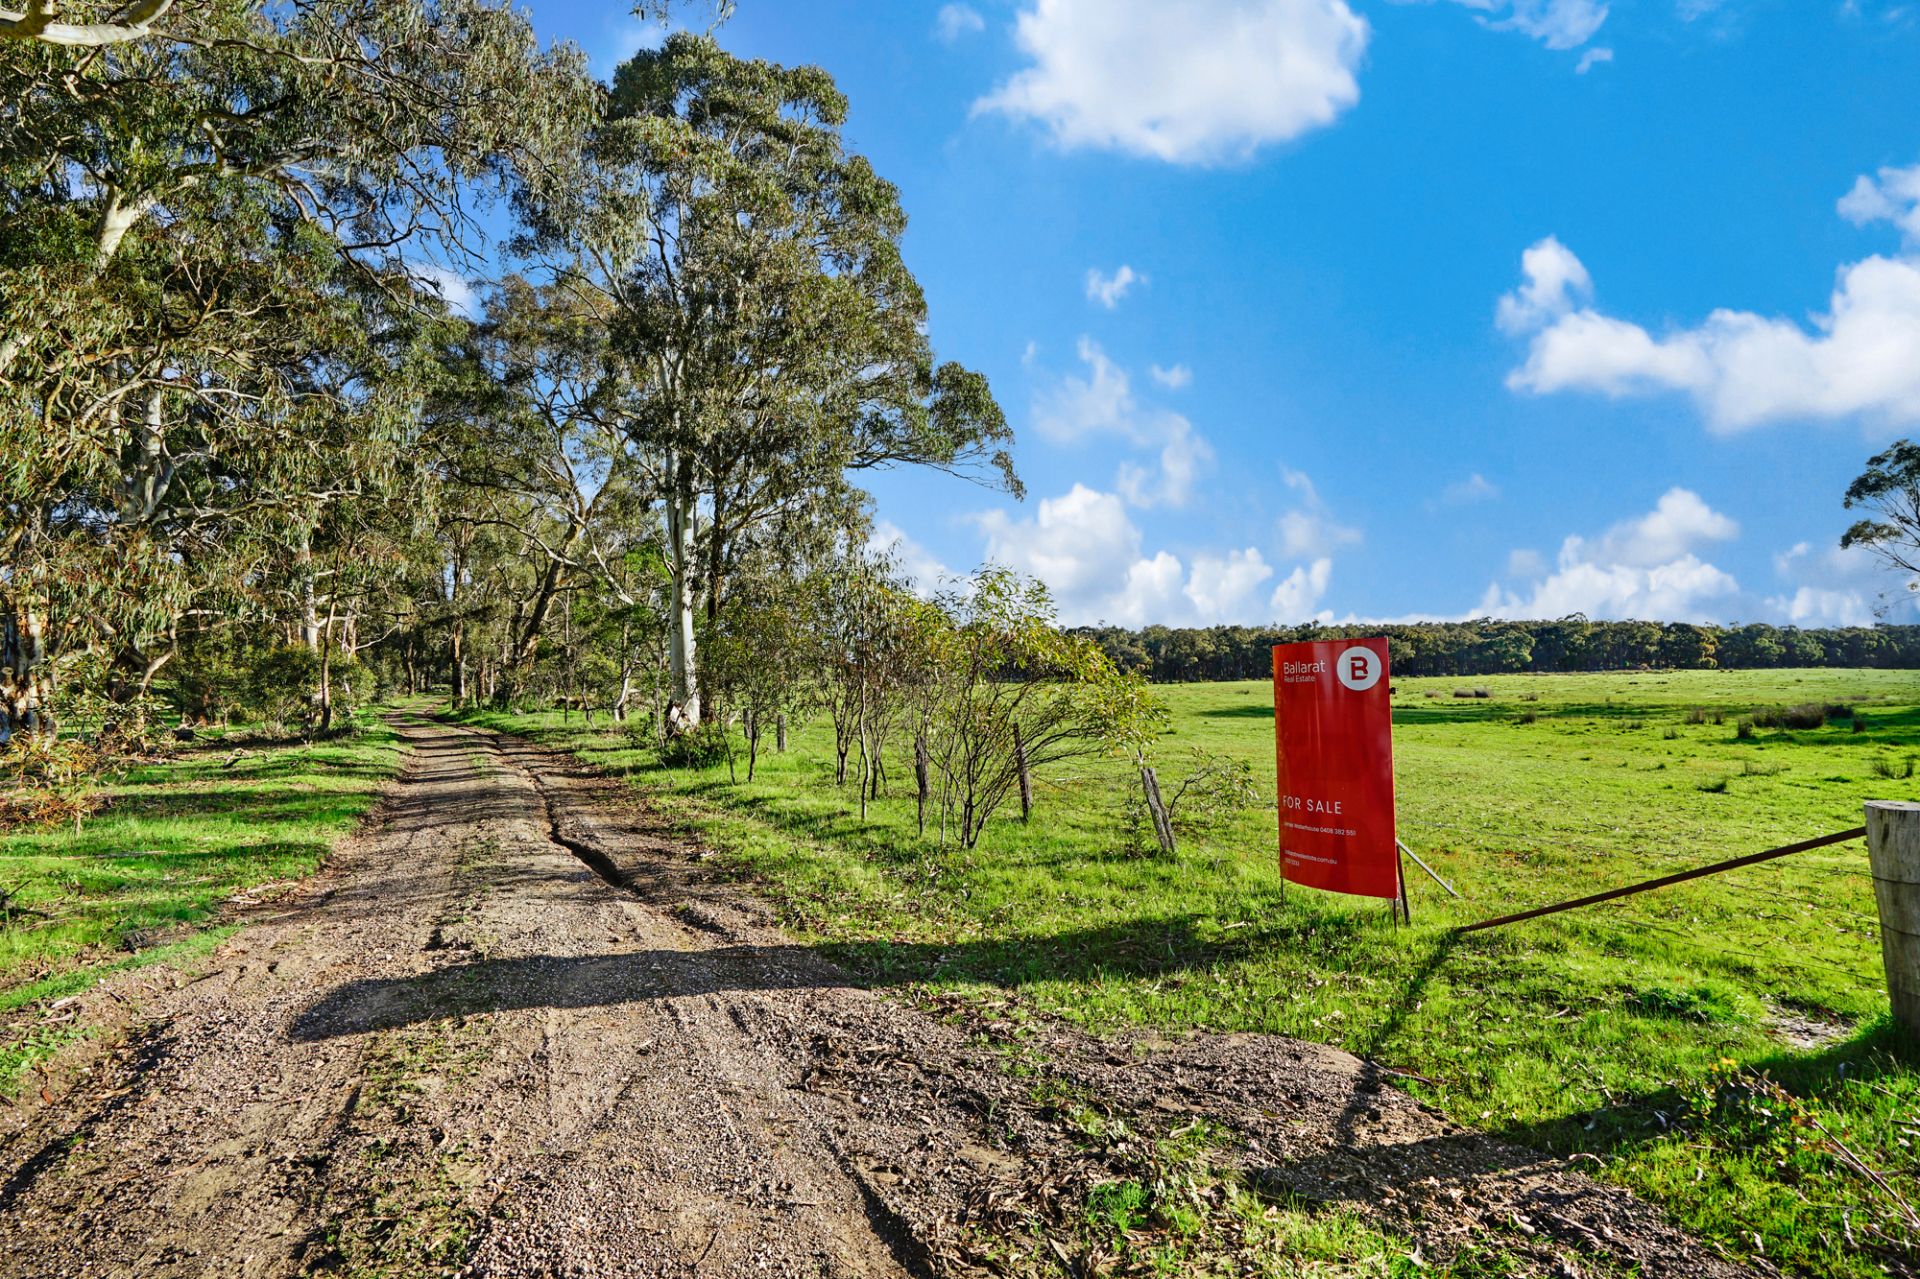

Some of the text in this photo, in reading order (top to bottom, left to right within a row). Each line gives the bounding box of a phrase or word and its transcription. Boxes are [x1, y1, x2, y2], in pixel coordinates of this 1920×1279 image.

[1283, 660, 1325, 674] Ballarat
[1351, 656, 1368, 680] B
[1283, 795, 1342, 814] FOR SALE
